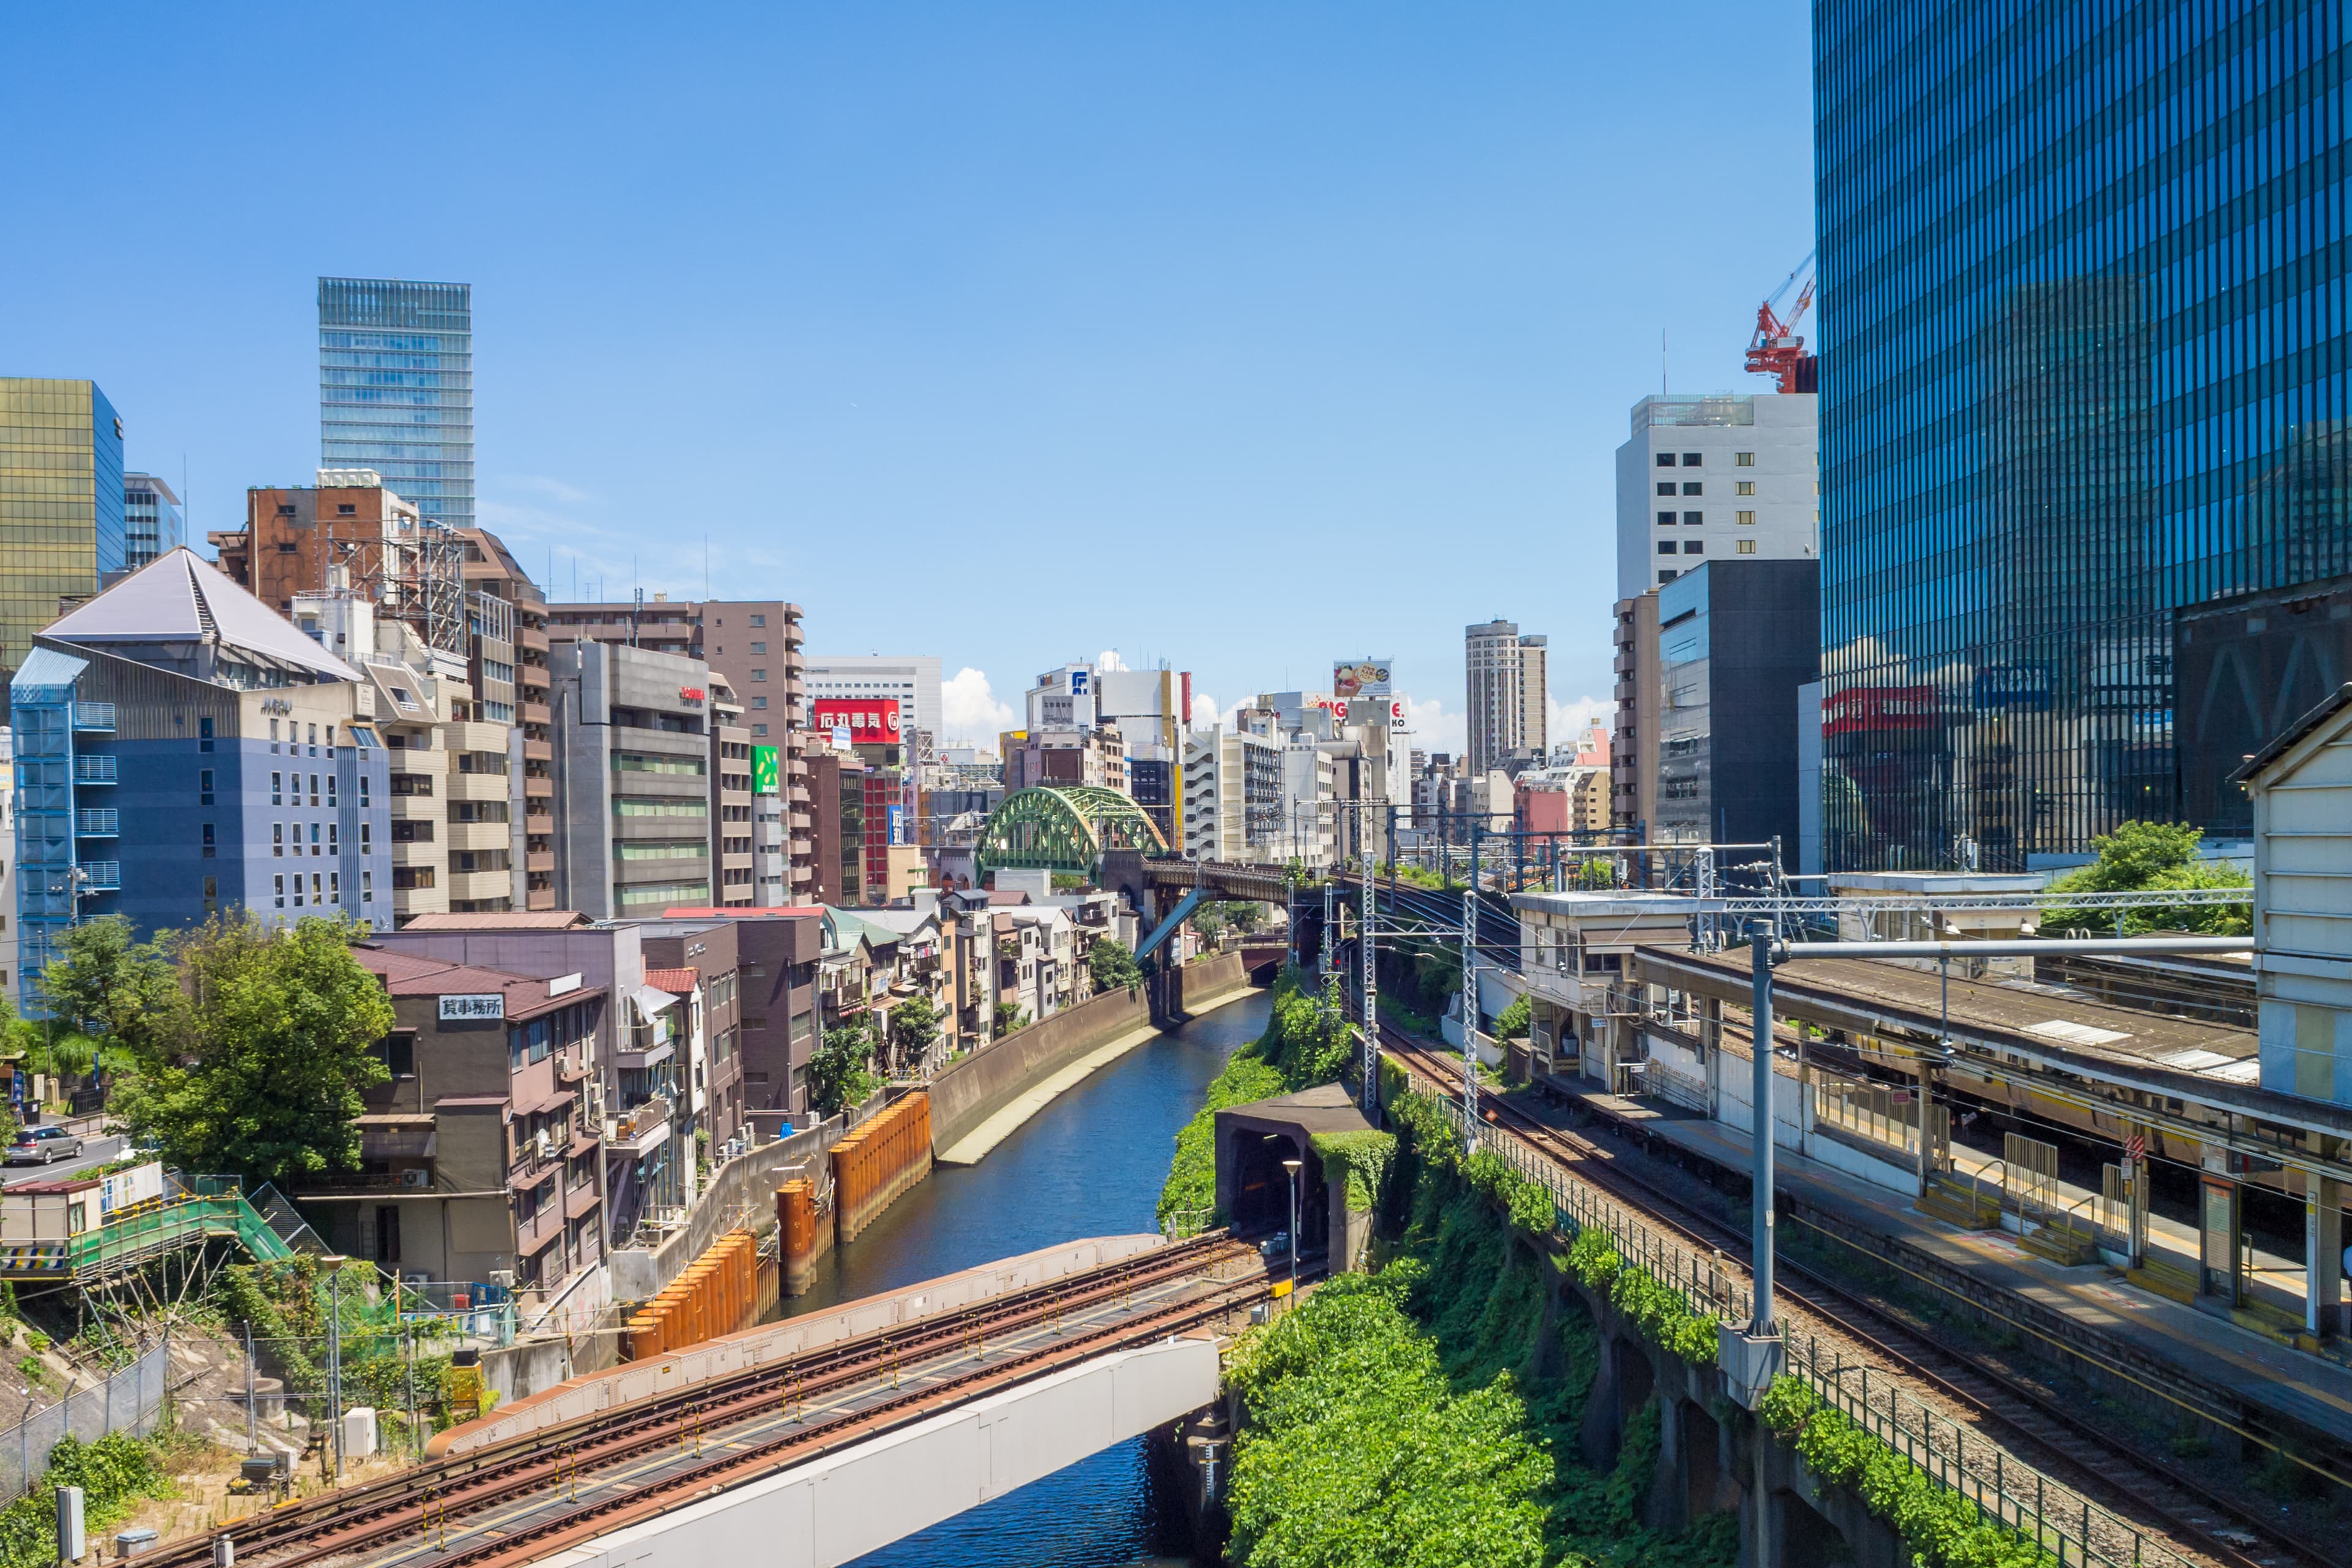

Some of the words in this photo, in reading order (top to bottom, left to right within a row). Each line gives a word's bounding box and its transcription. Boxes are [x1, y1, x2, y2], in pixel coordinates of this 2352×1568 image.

[820, 712, 881, 728] 石丸電気
[442, 998, 501, 1016] 貸事務所
